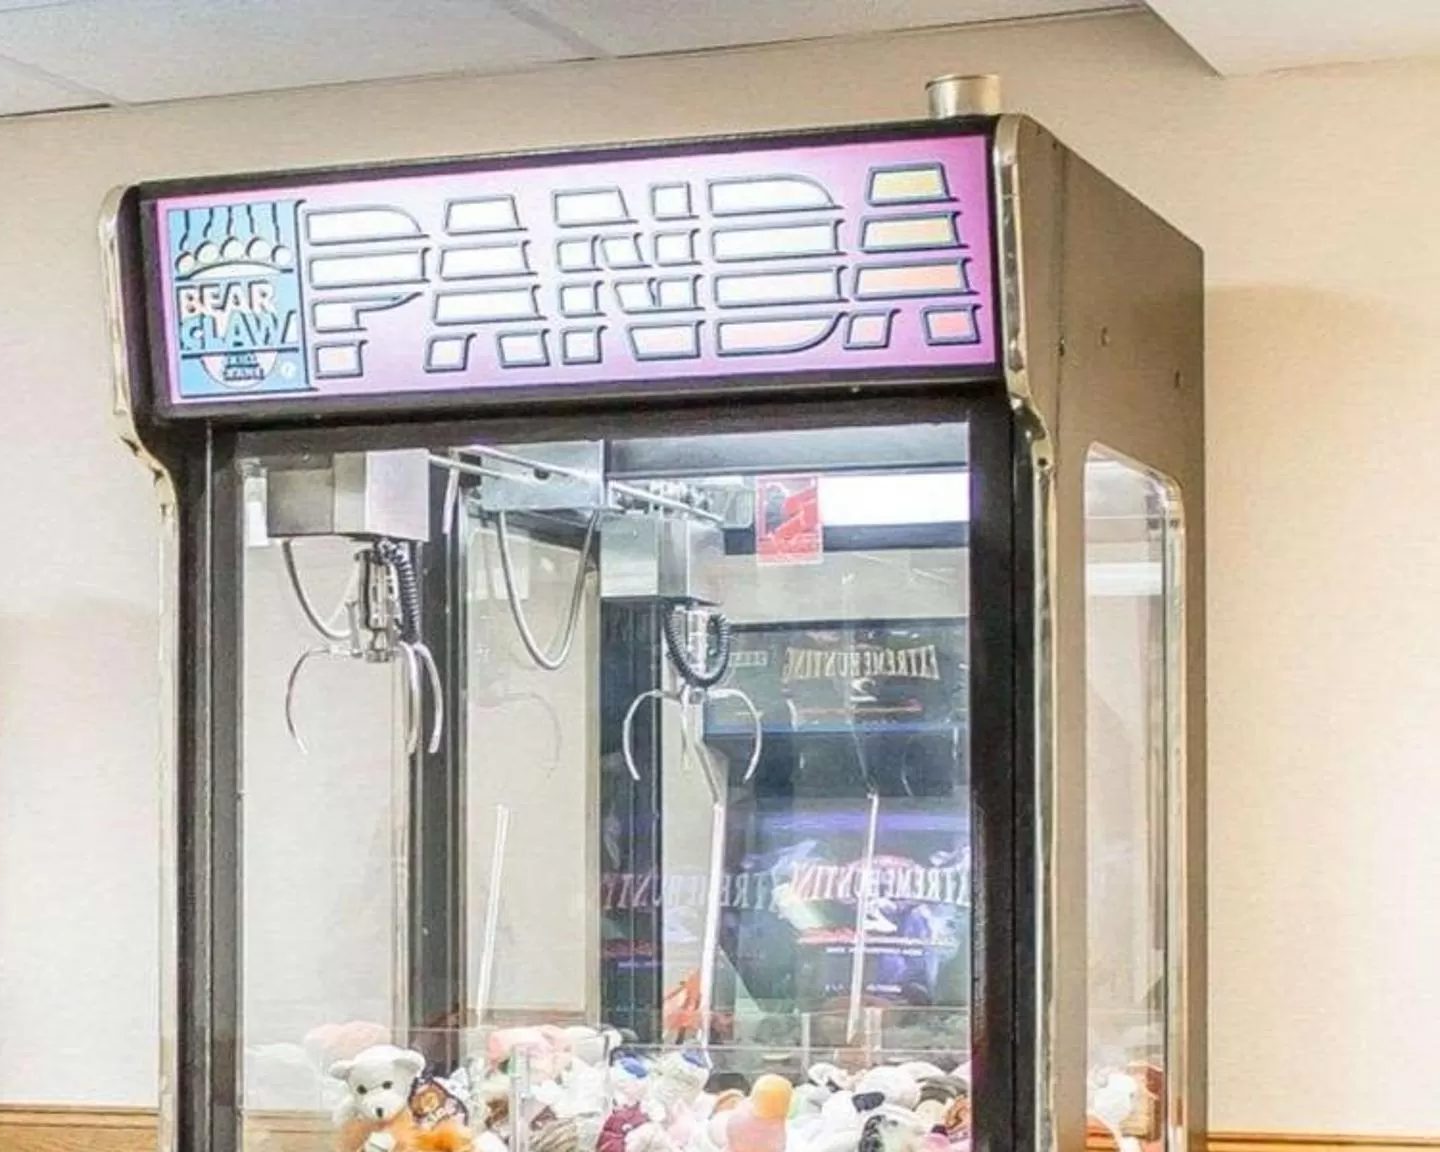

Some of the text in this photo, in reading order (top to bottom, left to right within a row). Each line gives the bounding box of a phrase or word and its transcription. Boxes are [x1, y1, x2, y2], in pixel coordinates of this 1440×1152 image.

[303, 162, 981, 380] PANDA
[176, 280, 276, 321] BEAR
[178, 312, 298, 351] CLAW
